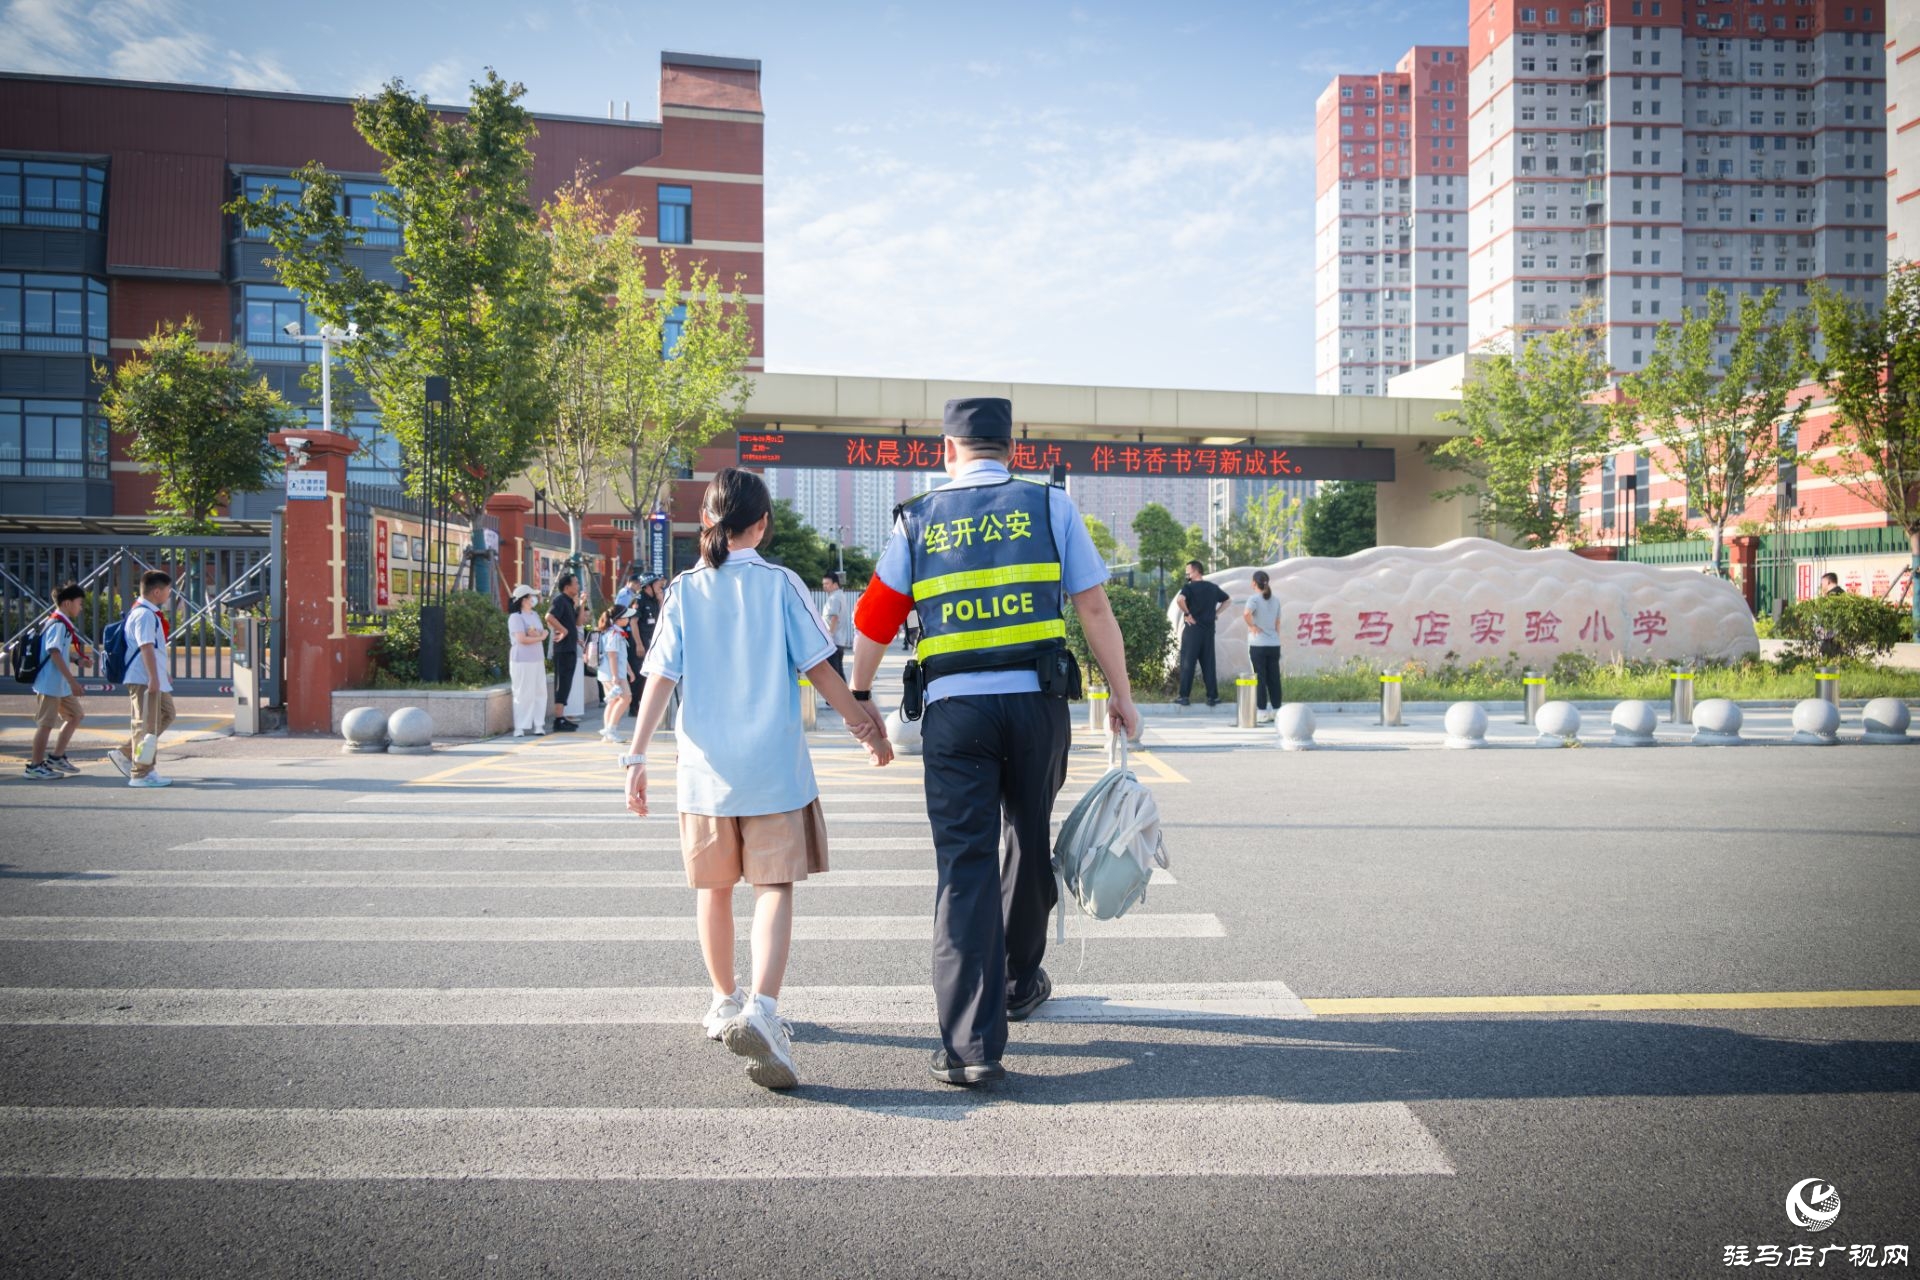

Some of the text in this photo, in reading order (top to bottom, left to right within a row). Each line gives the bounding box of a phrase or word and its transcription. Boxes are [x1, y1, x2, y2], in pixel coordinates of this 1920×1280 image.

[845, 437, 1306, 476] 沐晨光开起点，伴书香书写新成长。
[925, 510, 1031, 554] 经开公安
[941, 591, 1034, 624] POLICE
[1297, 609, 1668, 646] 驻马店实验小学
